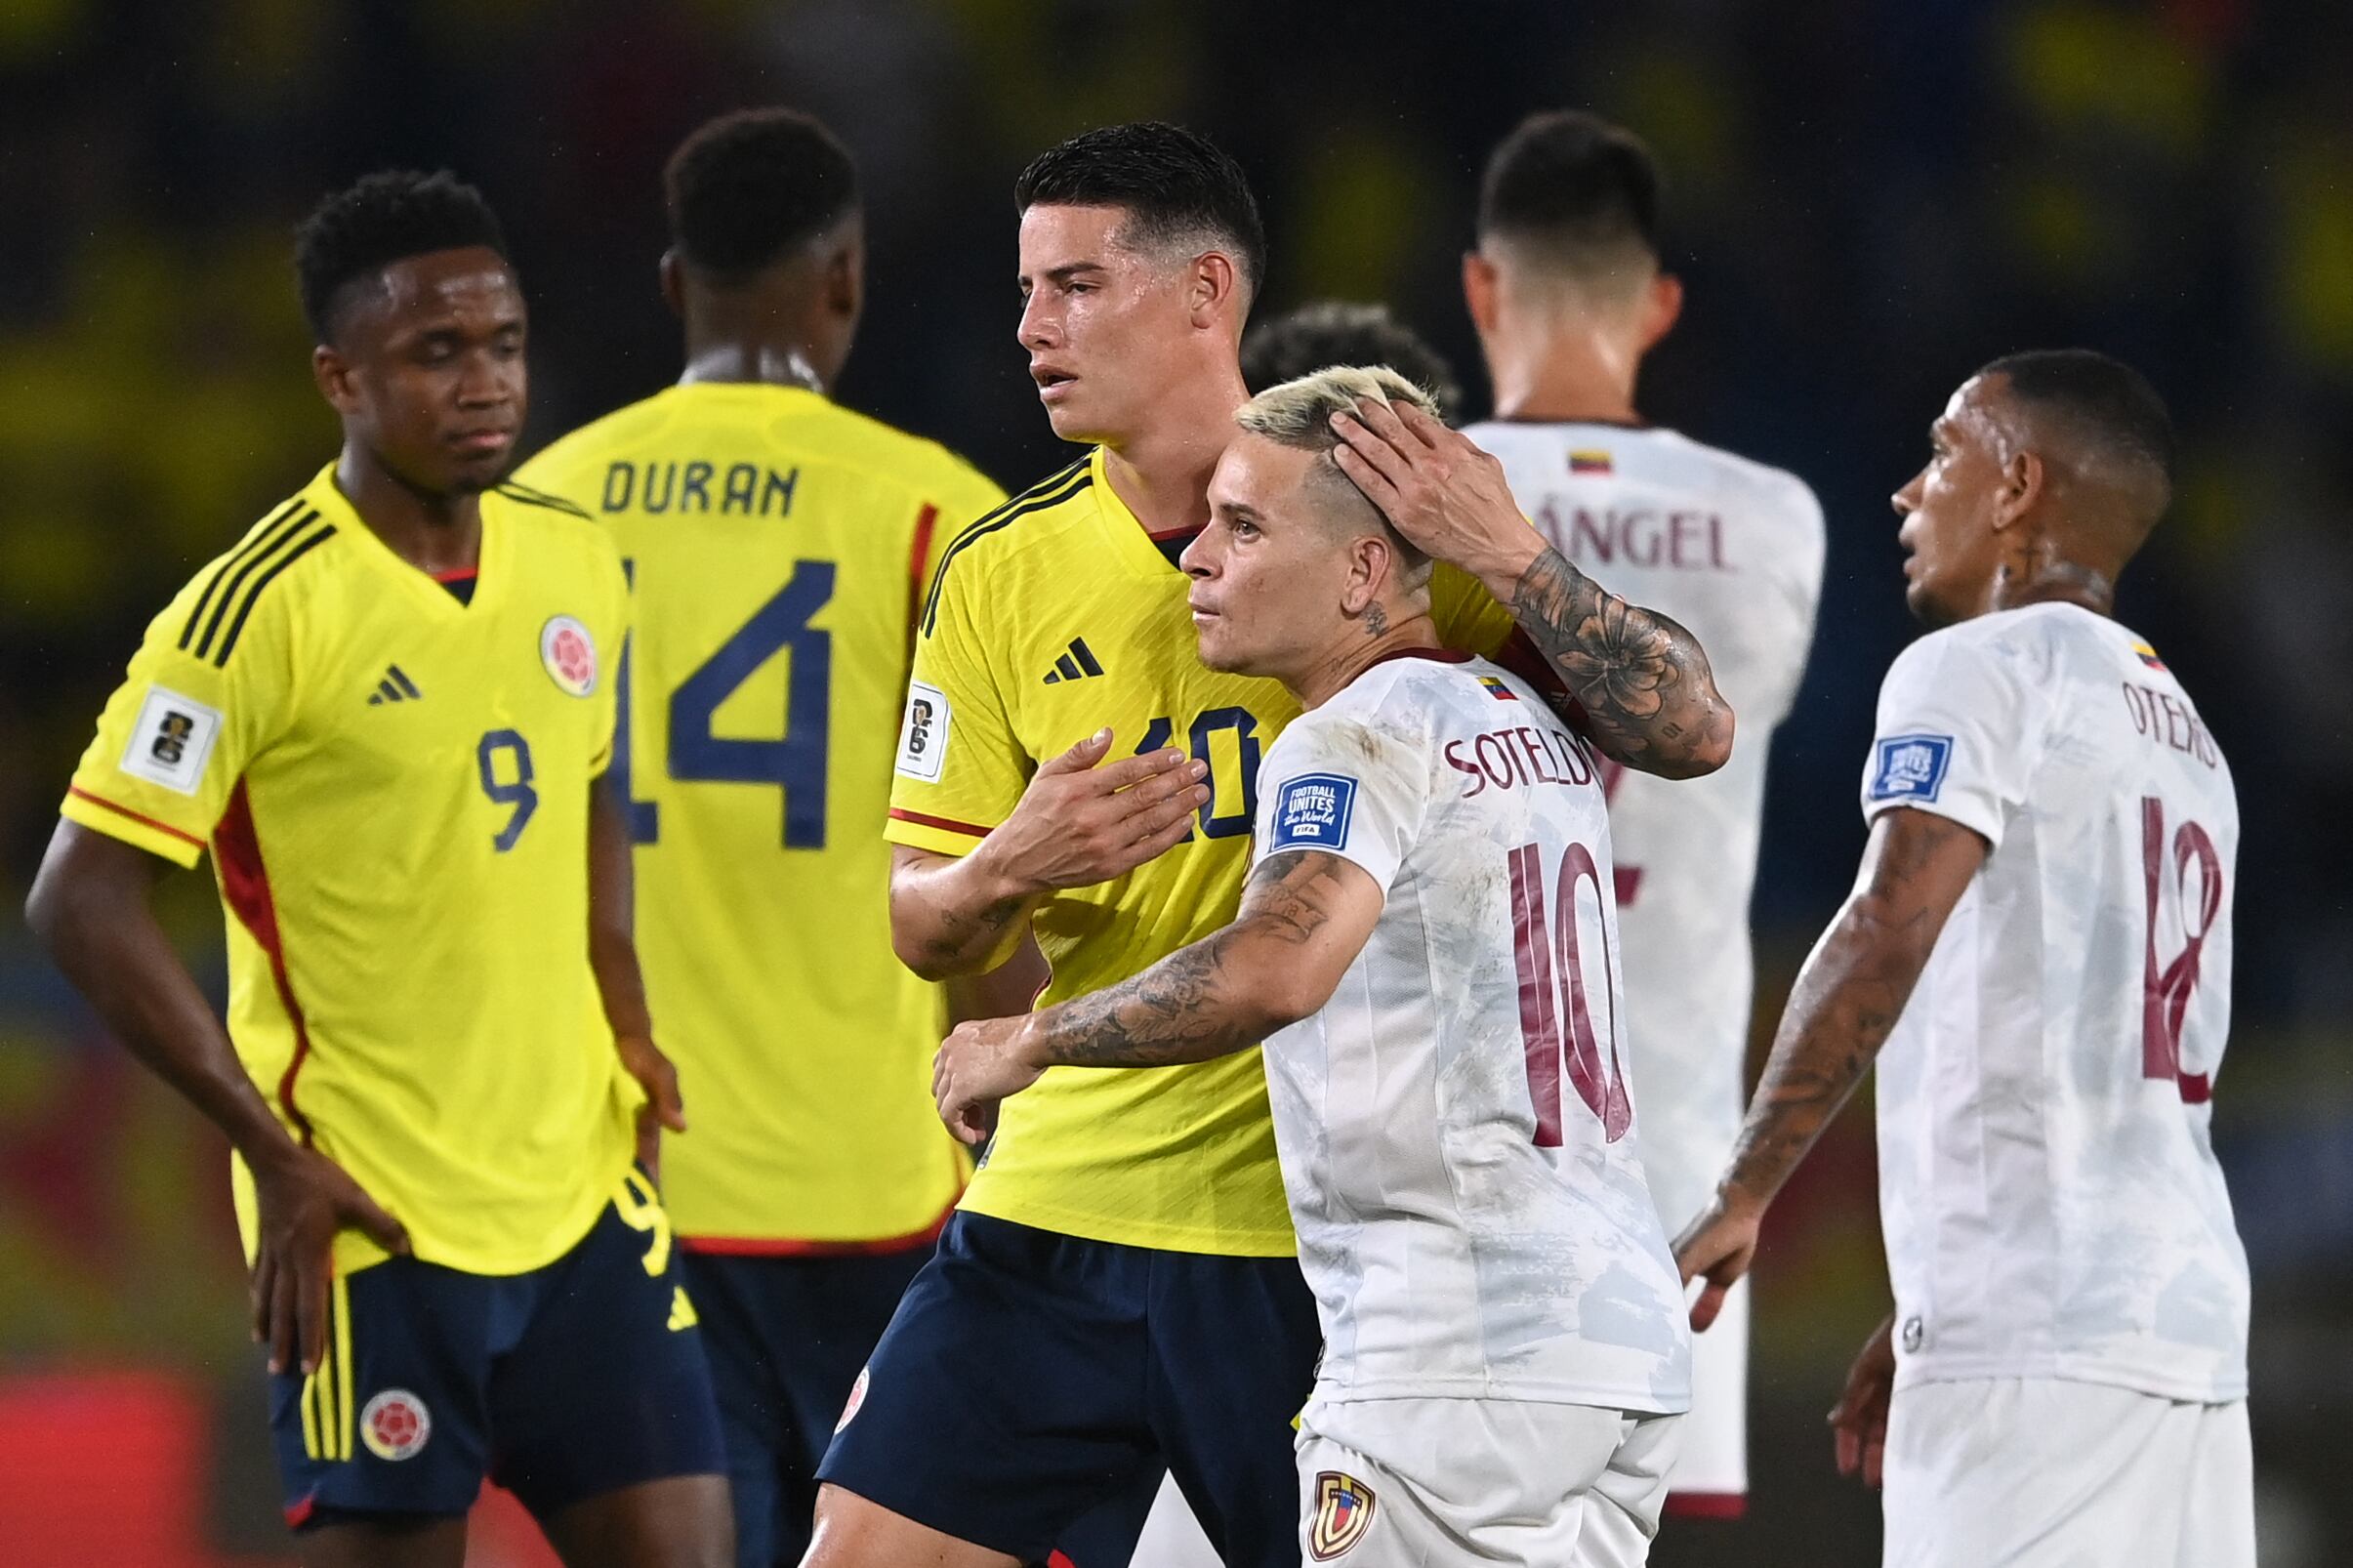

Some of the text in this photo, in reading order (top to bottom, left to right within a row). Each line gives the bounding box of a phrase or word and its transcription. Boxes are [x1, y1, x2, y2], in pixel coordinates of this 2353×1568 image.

[602, 461, 799, 516] DURAN
[476, 728, 538, 852] 9
[1289, 796, 1335, 813] UNITES
[1291, 785, 1336, 801] FOOTBALL
[1284, 810, 1336, 826] the World
[2141, 796, 2222, 1104] 18
[1507, 843, 1631, 1147] 10
